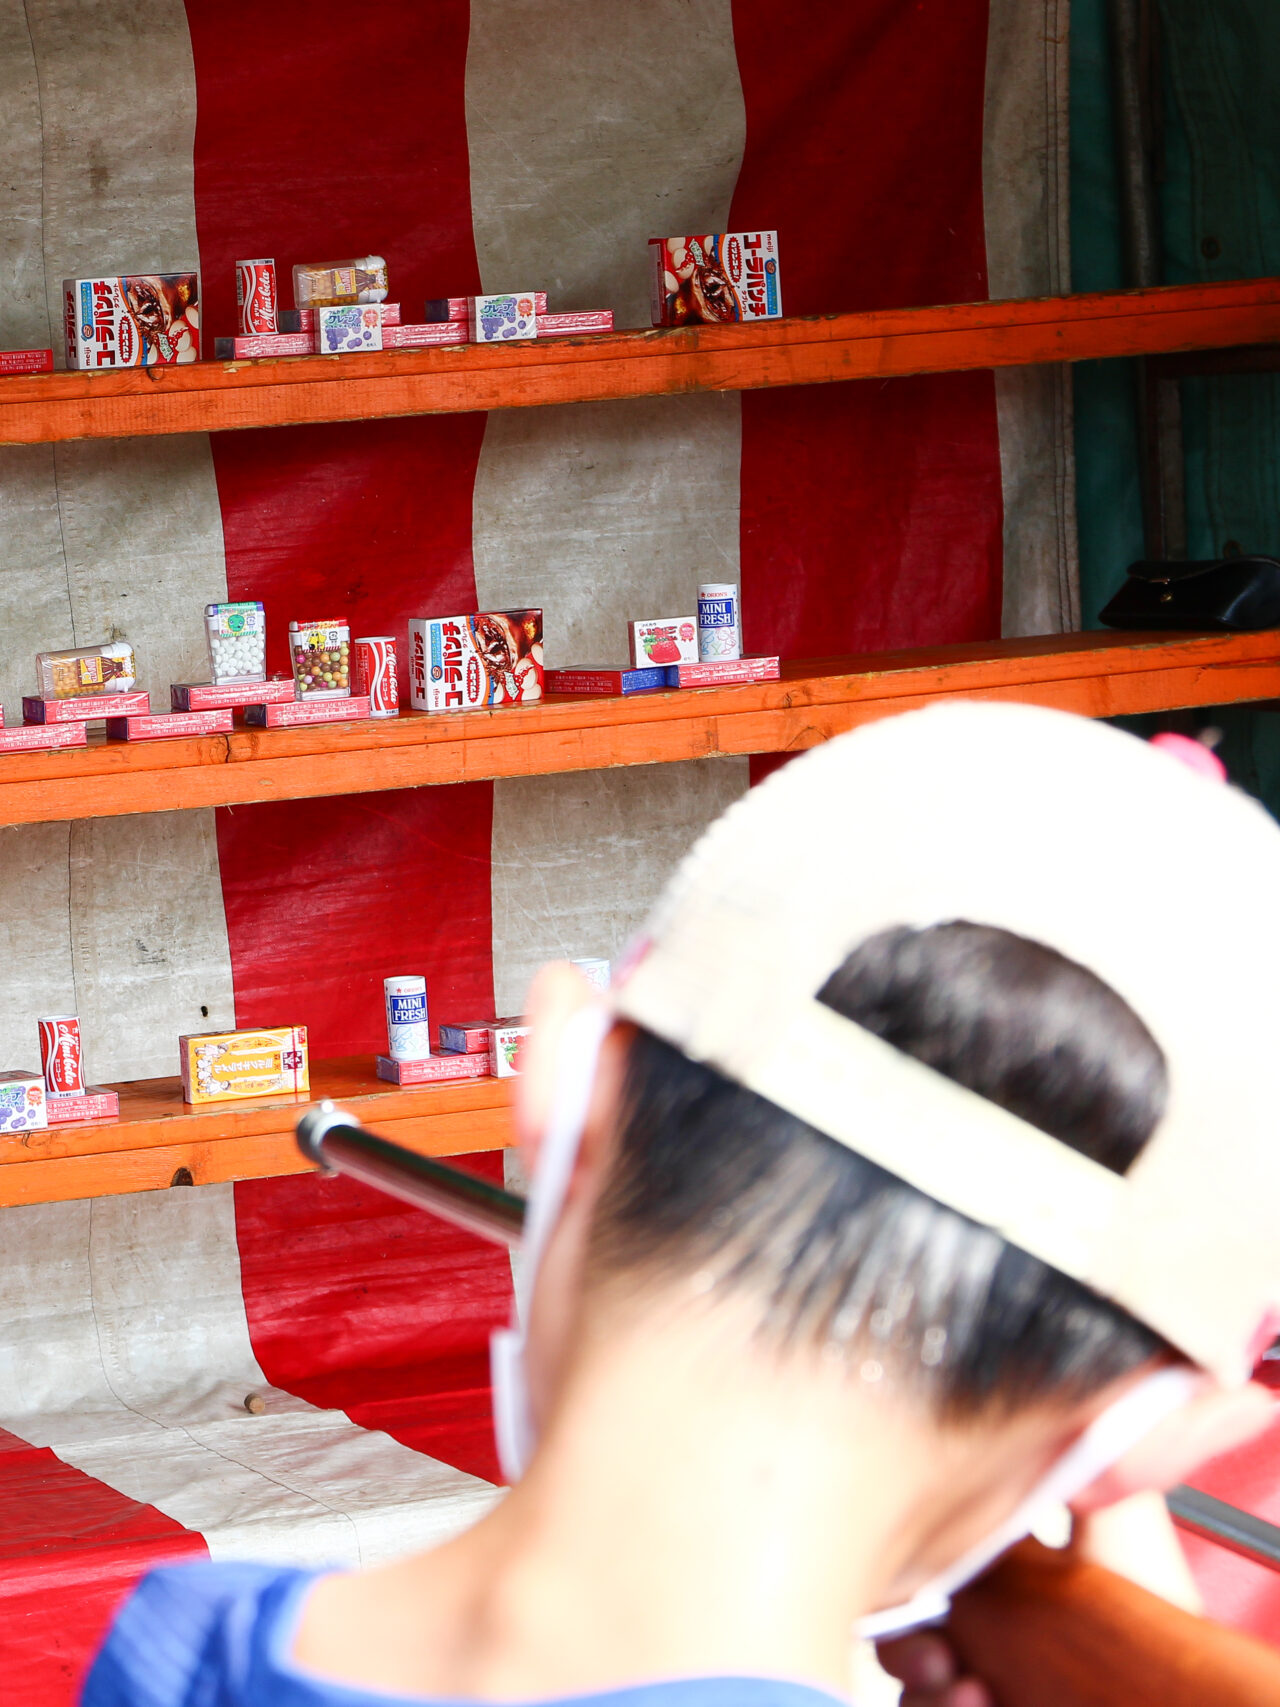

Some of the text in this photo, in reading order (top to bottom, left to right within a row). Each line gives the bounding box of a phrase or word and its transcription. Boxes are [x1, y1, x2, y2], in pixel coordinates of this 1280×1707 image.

[744, 234, 766, 316] コーラパンチ
[484, 304, 513, 314] グレープ
[66, 290, 76, 358] コーラパンチ
[92, 281, 116, 366] コーラパンチ
[328, 314, 358, 324] グレープ
[702, 603, 726, 614] MINI
[700, 614, 731, 625] FRESH
[639, 626, 678, 636] いちご
[414, 632, 425, 700] コーラパンチ
[442, 622, 463, 707] コーラパンチ
[398, 998, 422, 1010] MINI
[394, 1008, 426, 1021] FRESH
